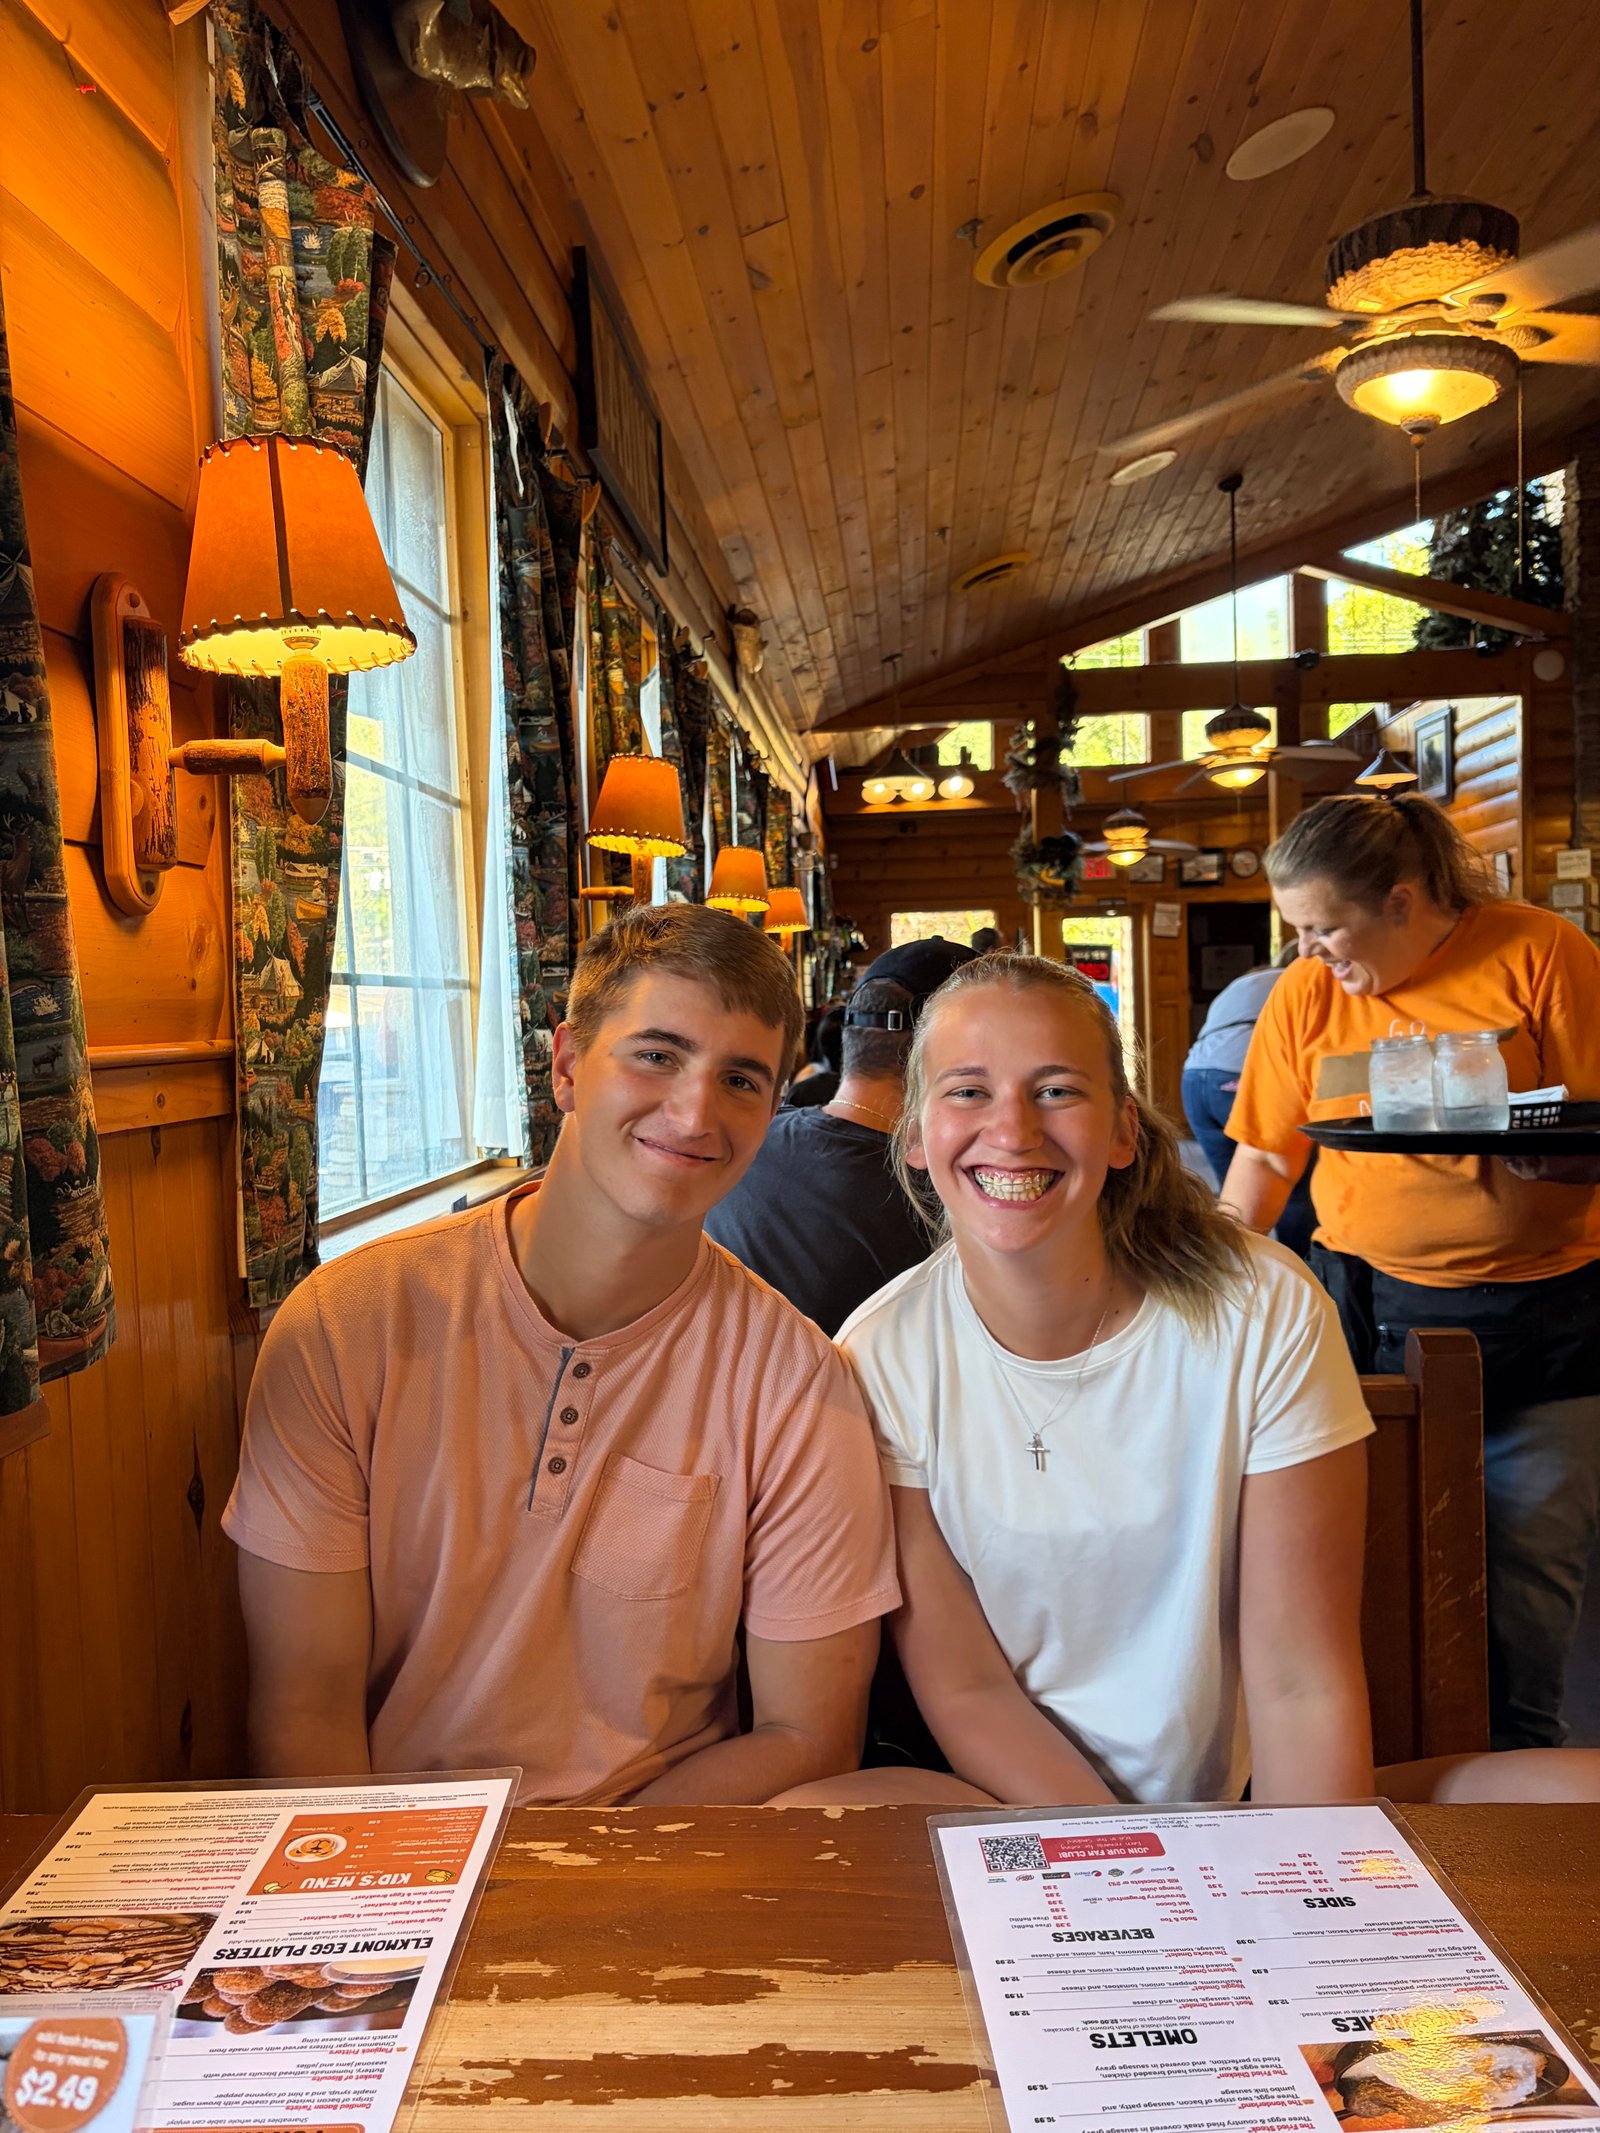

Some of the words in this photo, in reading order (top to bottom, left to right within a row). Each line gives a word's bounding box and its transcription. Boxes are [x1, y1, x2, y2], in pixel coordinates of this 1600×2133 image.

[1107, 1848, 1126, 1856] OUR
[1128, 1847, 1150, 1855] JOIN
[300, 1875, 355, 1889] MENU
[359, 1873, 411, 1886] KID'S
[1303, 1896, 1356, 1909] SIDES
[1052, 1928, 1154, 1943] BEVERAGES
[310, 1942, 347, 1955] EGG
[350, 1937, 432, 1953] ELKMONT
[213, 1944, 306, 1960] PLATTERS
[1090, 2029, 1198, 2049] OMELETS
[361, 2046, 393, 2054] Flapjack
[1209, 2057, 1251, 2066] perfection,
[15, 2066, 99, 2111] $2.49
[1269, 2085, 1296, 2093] jumbo
[1118, 2102, 1141, 2110] patty,
[1214, 2096, 1236, 2104] strips
[1034, 2116, 1056, 2124] 16.99
